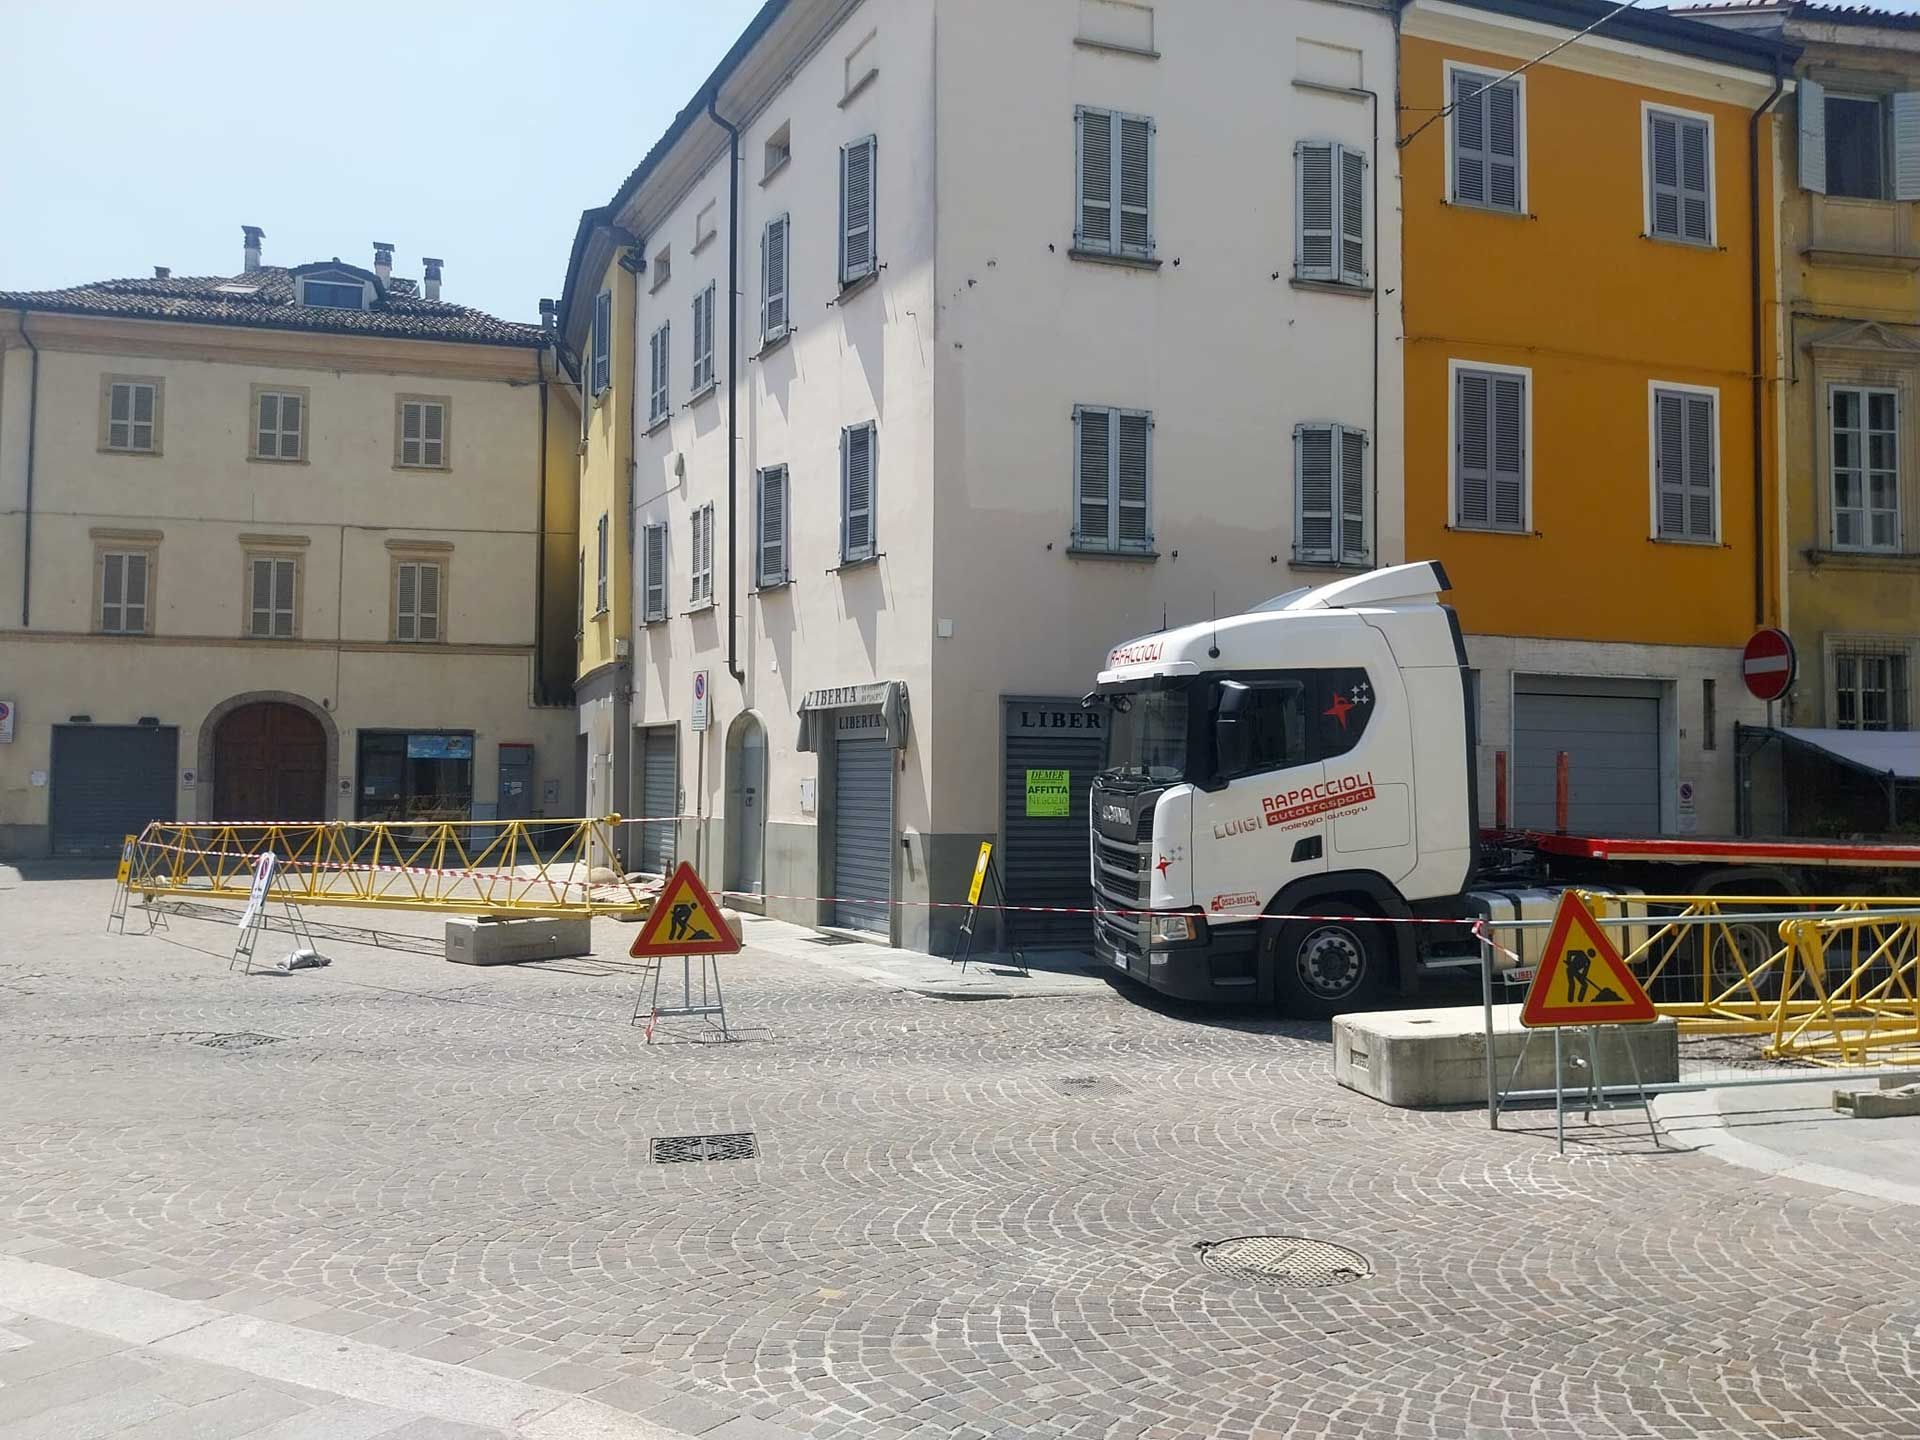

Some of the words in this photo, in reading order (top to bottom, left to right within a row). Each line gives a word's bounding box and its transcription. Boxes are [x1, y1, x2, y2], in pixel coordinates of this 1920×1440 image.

[806, 686, 857, 706] LIBERTA
[1021, 711, 1102, 729] LIBER
[1028, 785, 1069, 794] AFFITTA
[1262, 771, 1373, 813] RAPACCIOLI
[1268, 788, 1374, 824] autotrasporti
[1280, 816, 1323, 832] noleggio
[1327, 804, 1369, 820] autogru
[1213, 814, 1263, 840] LUIGI
